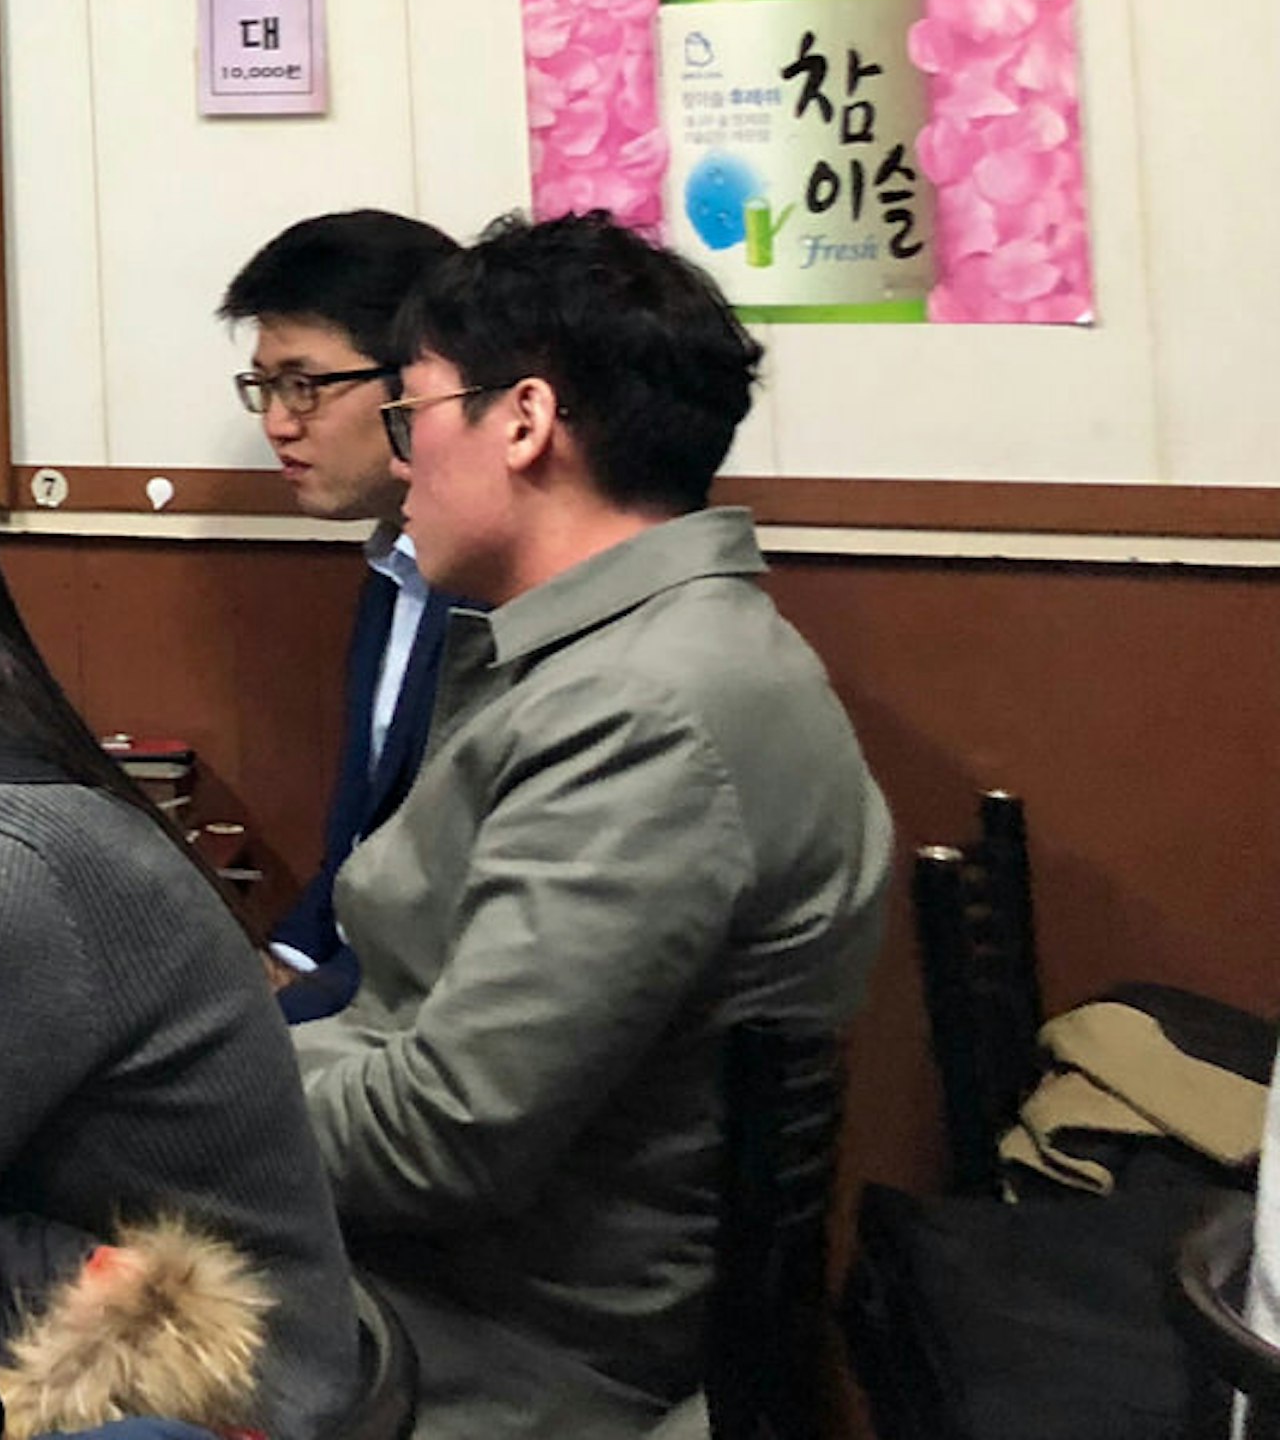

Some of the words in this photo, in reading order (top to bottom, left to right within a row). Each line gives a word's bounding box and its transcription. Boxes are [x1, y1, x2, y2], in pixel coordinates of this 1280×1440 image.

[220, 64, 303, 80] 10,000원
[796, 233, 878, 271] Fresh
[42, 477, 56, 497] 7
